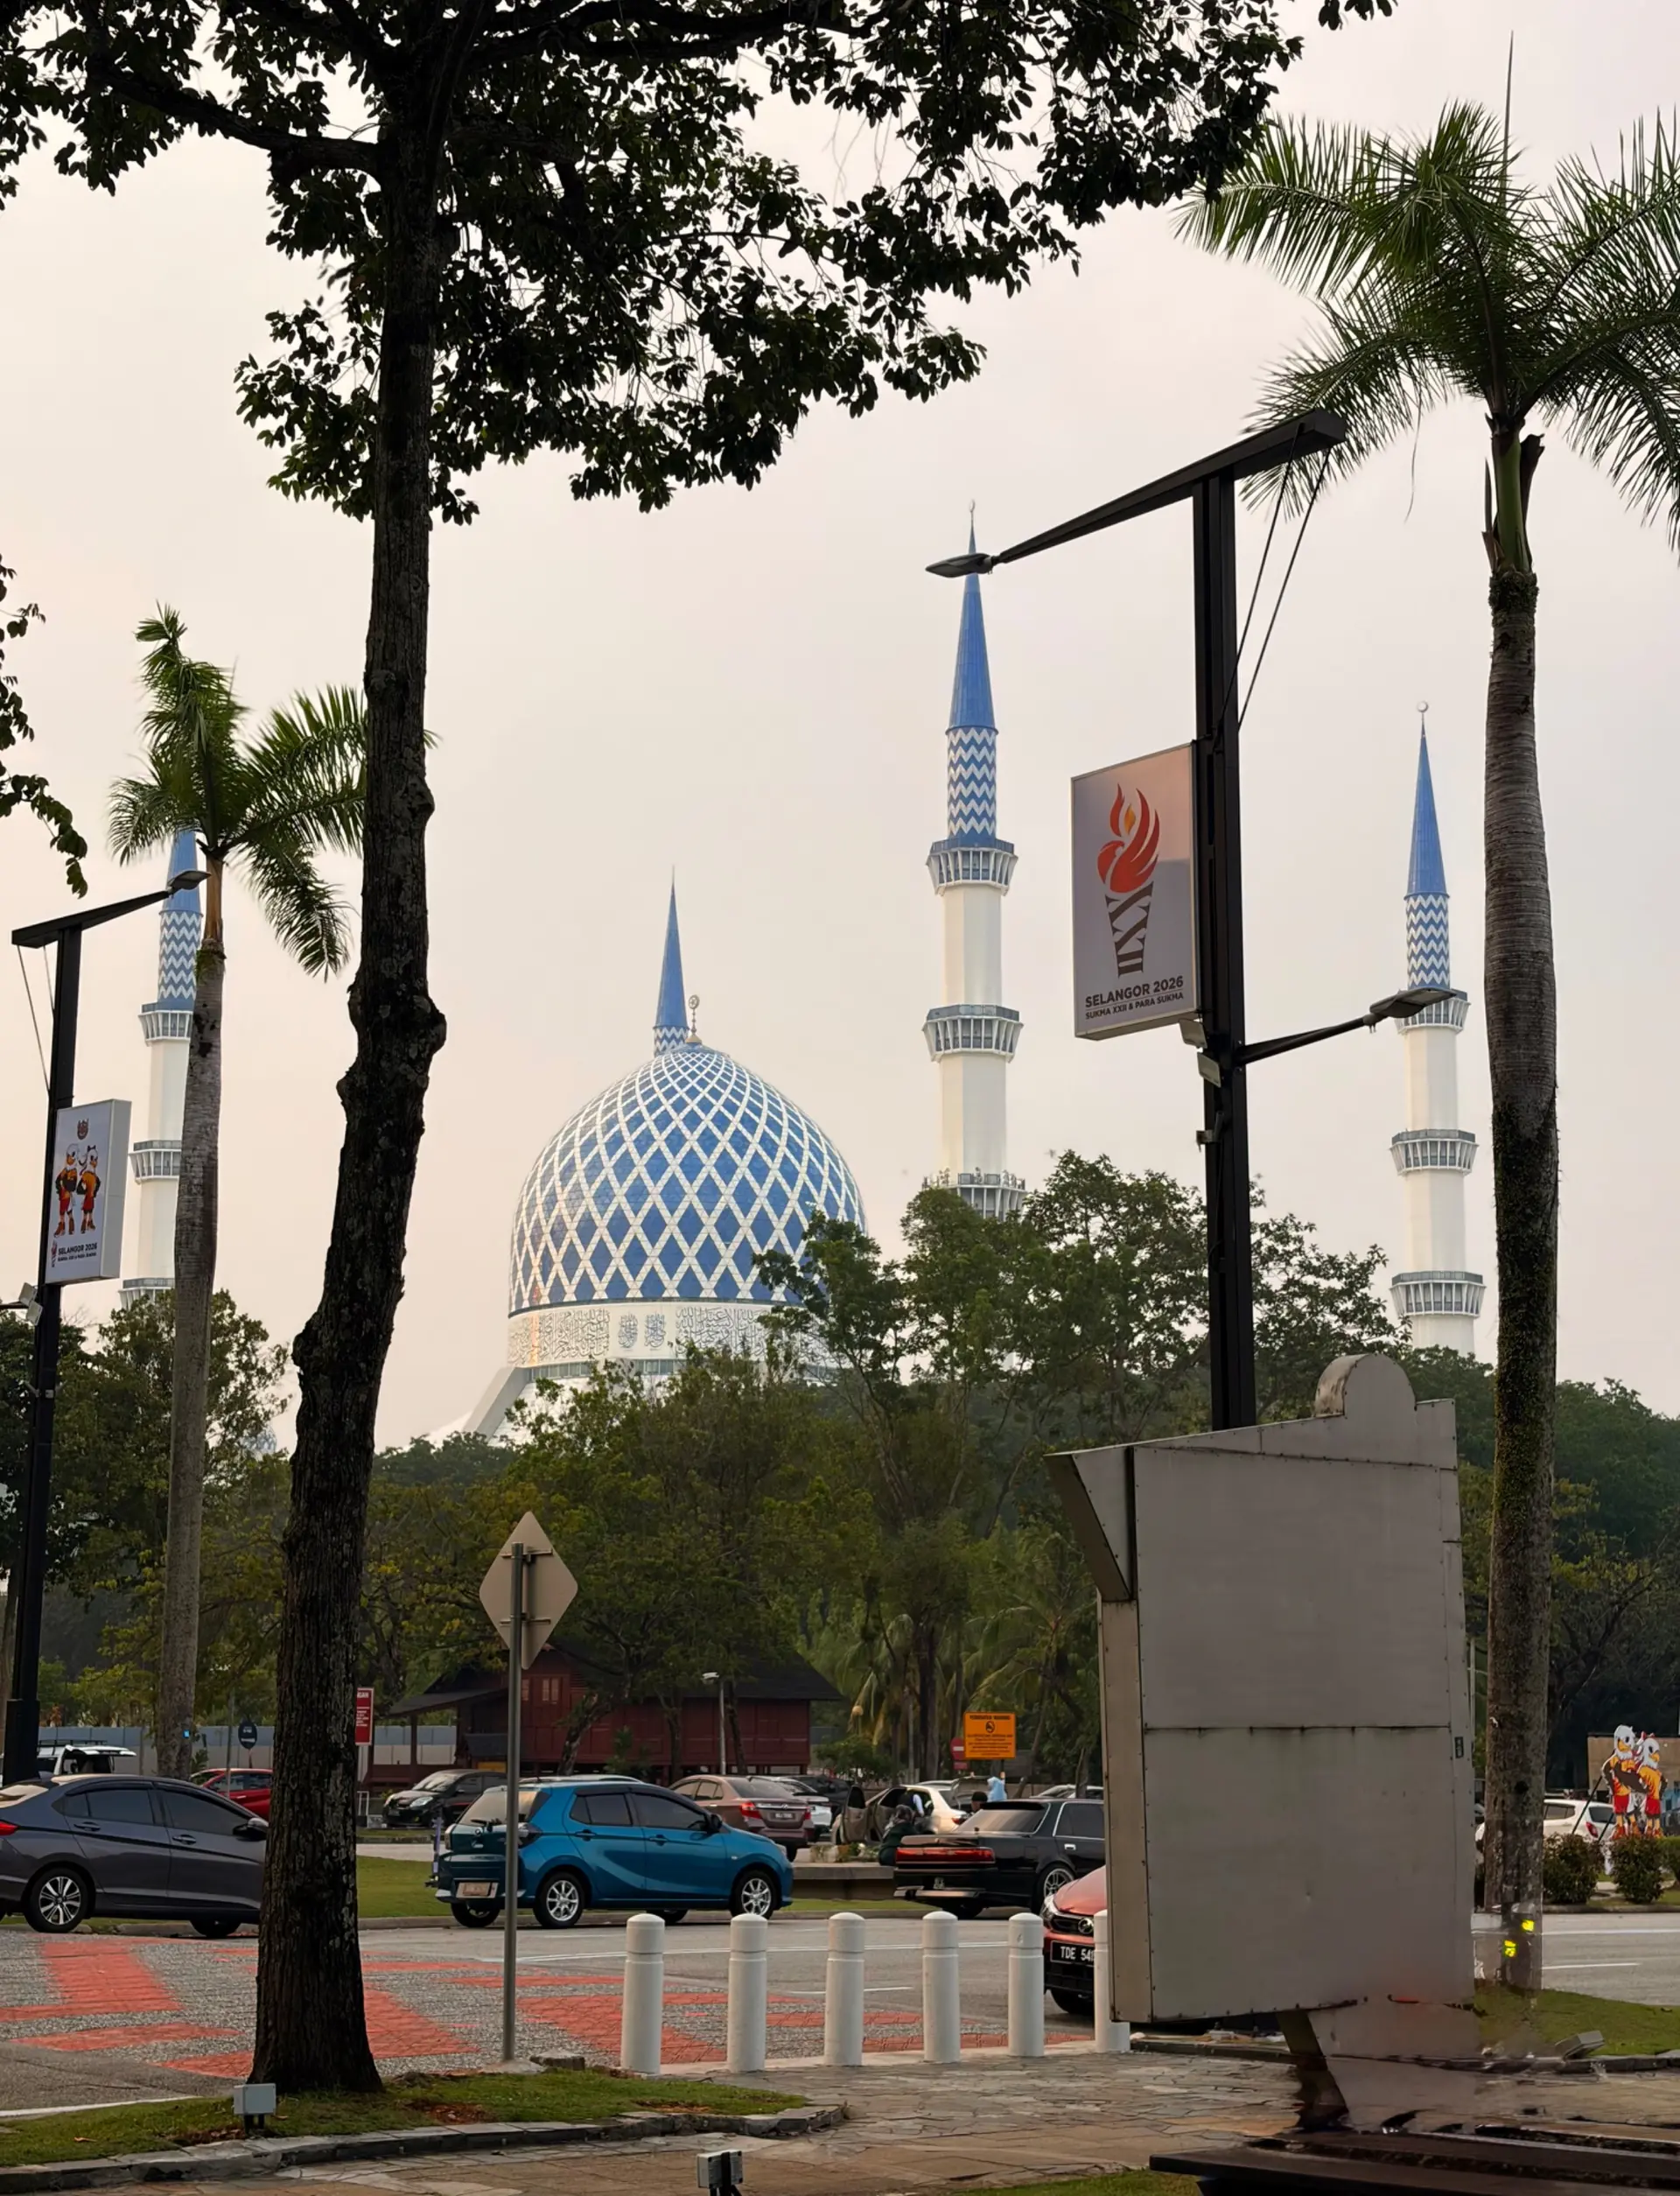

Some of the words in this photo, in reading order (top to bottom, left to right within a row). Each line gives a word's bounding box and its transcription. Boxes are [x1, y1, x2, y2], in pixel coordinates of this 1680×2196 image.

[1085, 984, 1150, 1007] SELANGOR
[1153, 975, 1184, 993] 2026
[1085, 1007, 1111, 1021] SUKMA
[1112, 1003, 1128, 1014] XXII
[1128, 1002, 1134, 1011] &
[1135, 998, 1155, 1009] PARA
[1157, 992, 1184, 1005] SUKMA
[58, 1244, 84, 1255] SELANGOR
[1060, 1946, 1076, 1961] TDE
